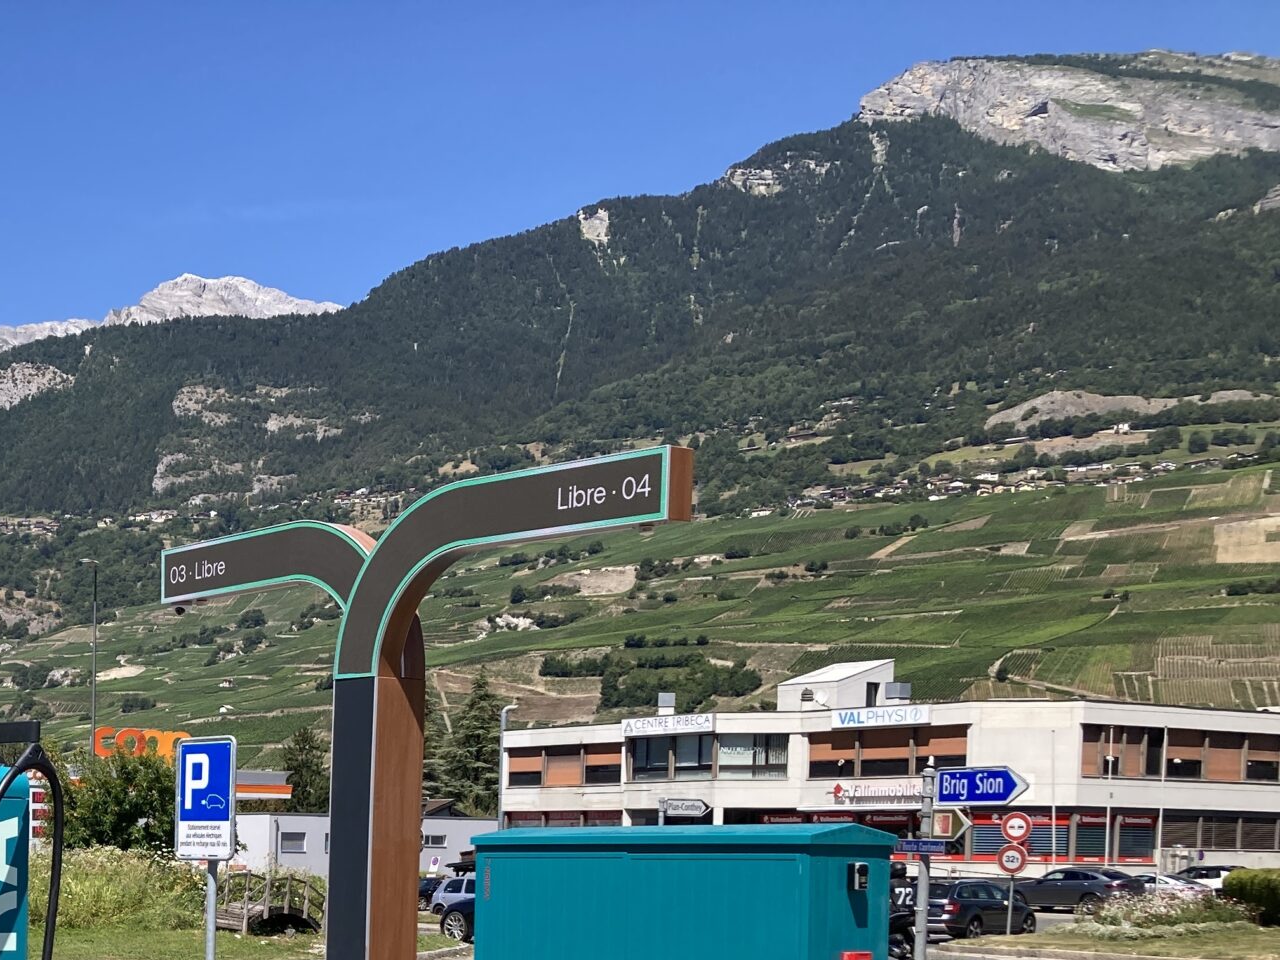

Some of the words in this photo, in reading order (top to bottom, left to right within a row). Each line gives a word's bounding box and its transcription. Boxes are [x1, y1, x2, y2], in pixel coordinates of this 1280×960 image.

[557, 485, 606, 511] Libre
[621, 473, 652, 501] 04
[170, 565, 186, 584] 03
[195, 558, 226, 581] Libre
[634, 717, 669, 730] CENTRE
[672, 715, 710, 727] TRIBECA
[184, 753, 210, 809] P
[847, 784, 923, 796] Valimmobilie
[942, 774, 967, 800] Brig
[975, 772, 1004, 794] Sion
[894, 887, 914, 905] 72
